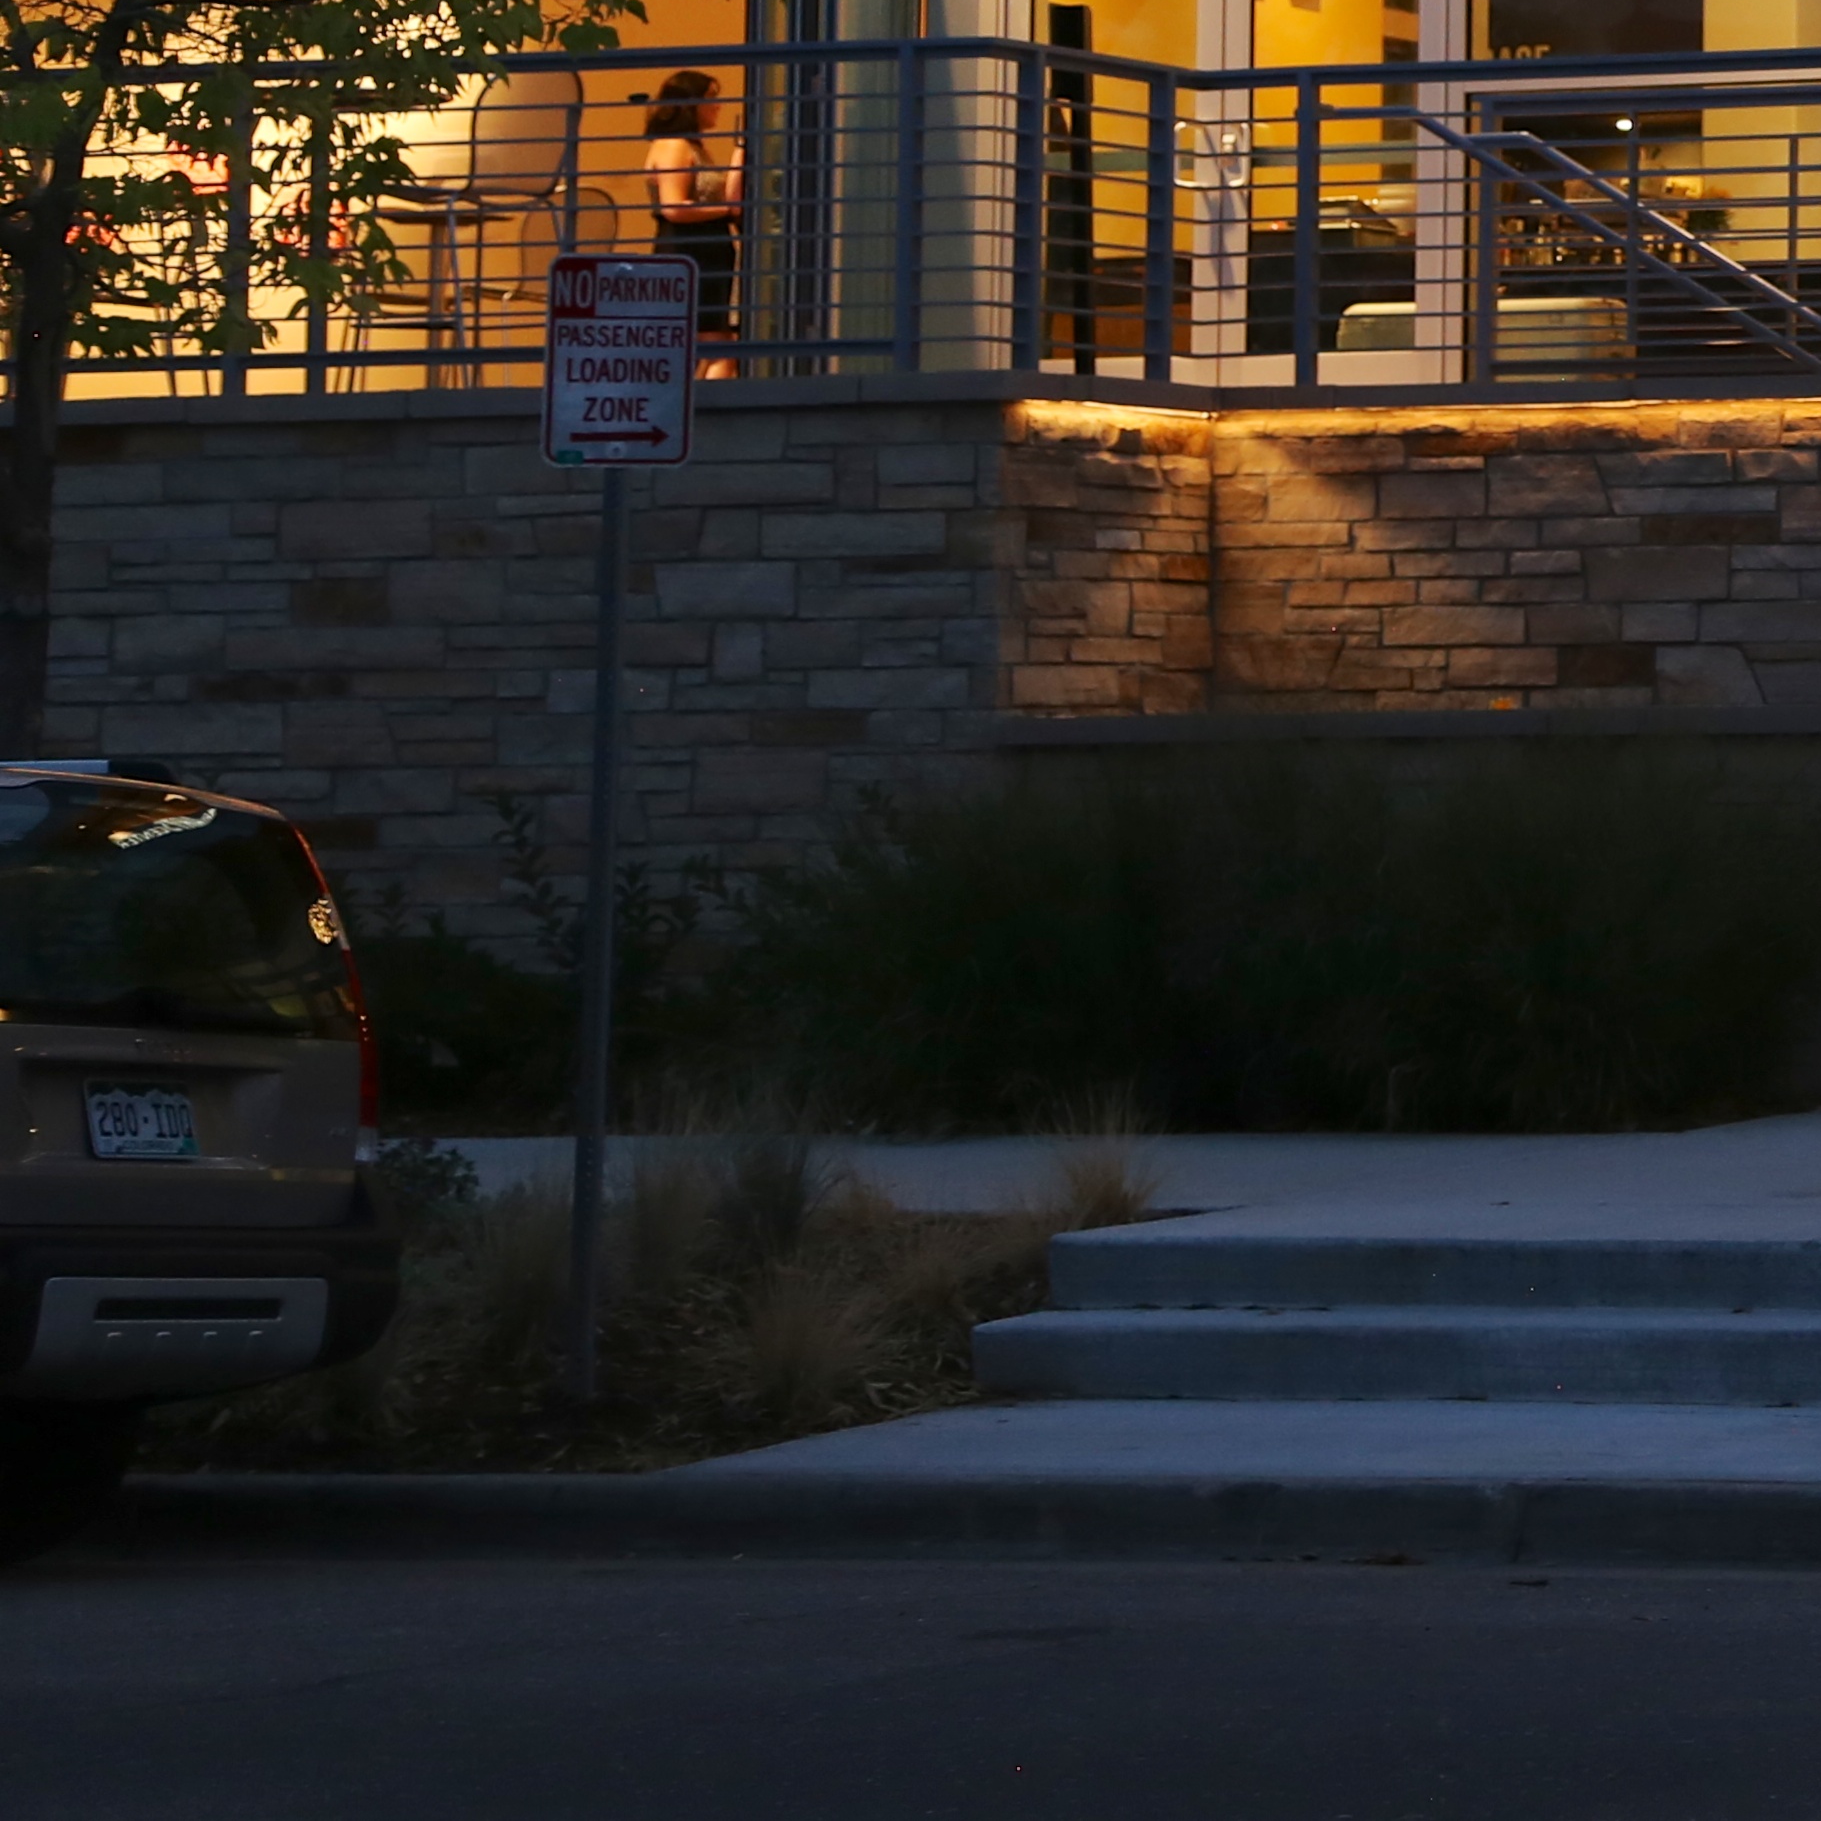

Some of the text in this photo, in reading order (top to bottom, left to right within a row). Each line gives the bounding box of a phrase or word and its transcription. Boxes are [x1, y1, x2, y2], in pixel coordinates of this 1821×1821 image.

[555, 270, 686, 308] NO PARKING
[557, 326, 685, 348] PASSENGER
[566, 358, 671, 384] LOADING
[582, 397, 650, 423] ZONE
